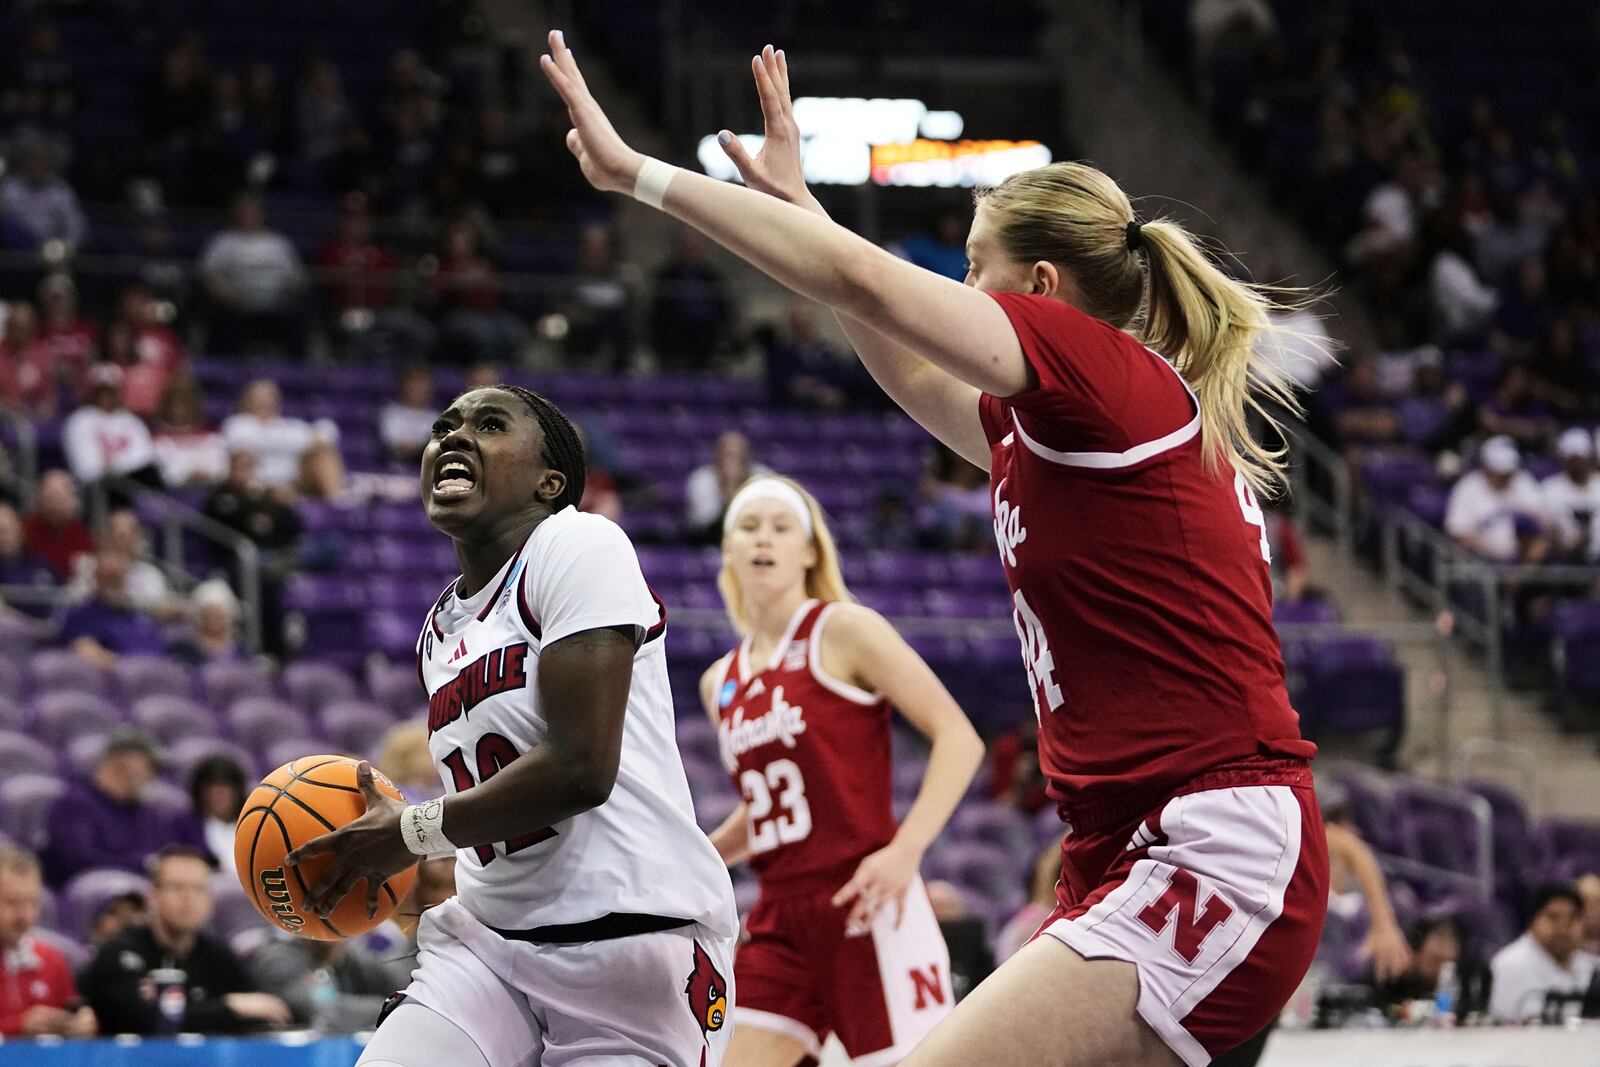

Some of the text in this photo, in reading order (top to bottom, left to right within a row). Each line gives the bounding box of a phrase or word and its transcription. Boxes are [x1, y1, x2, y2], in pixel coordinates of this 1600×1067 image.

[741, 758, 812, 852] 23
[1134, 867, 1235, 966] N
[908, 963, 945, 1010] N
